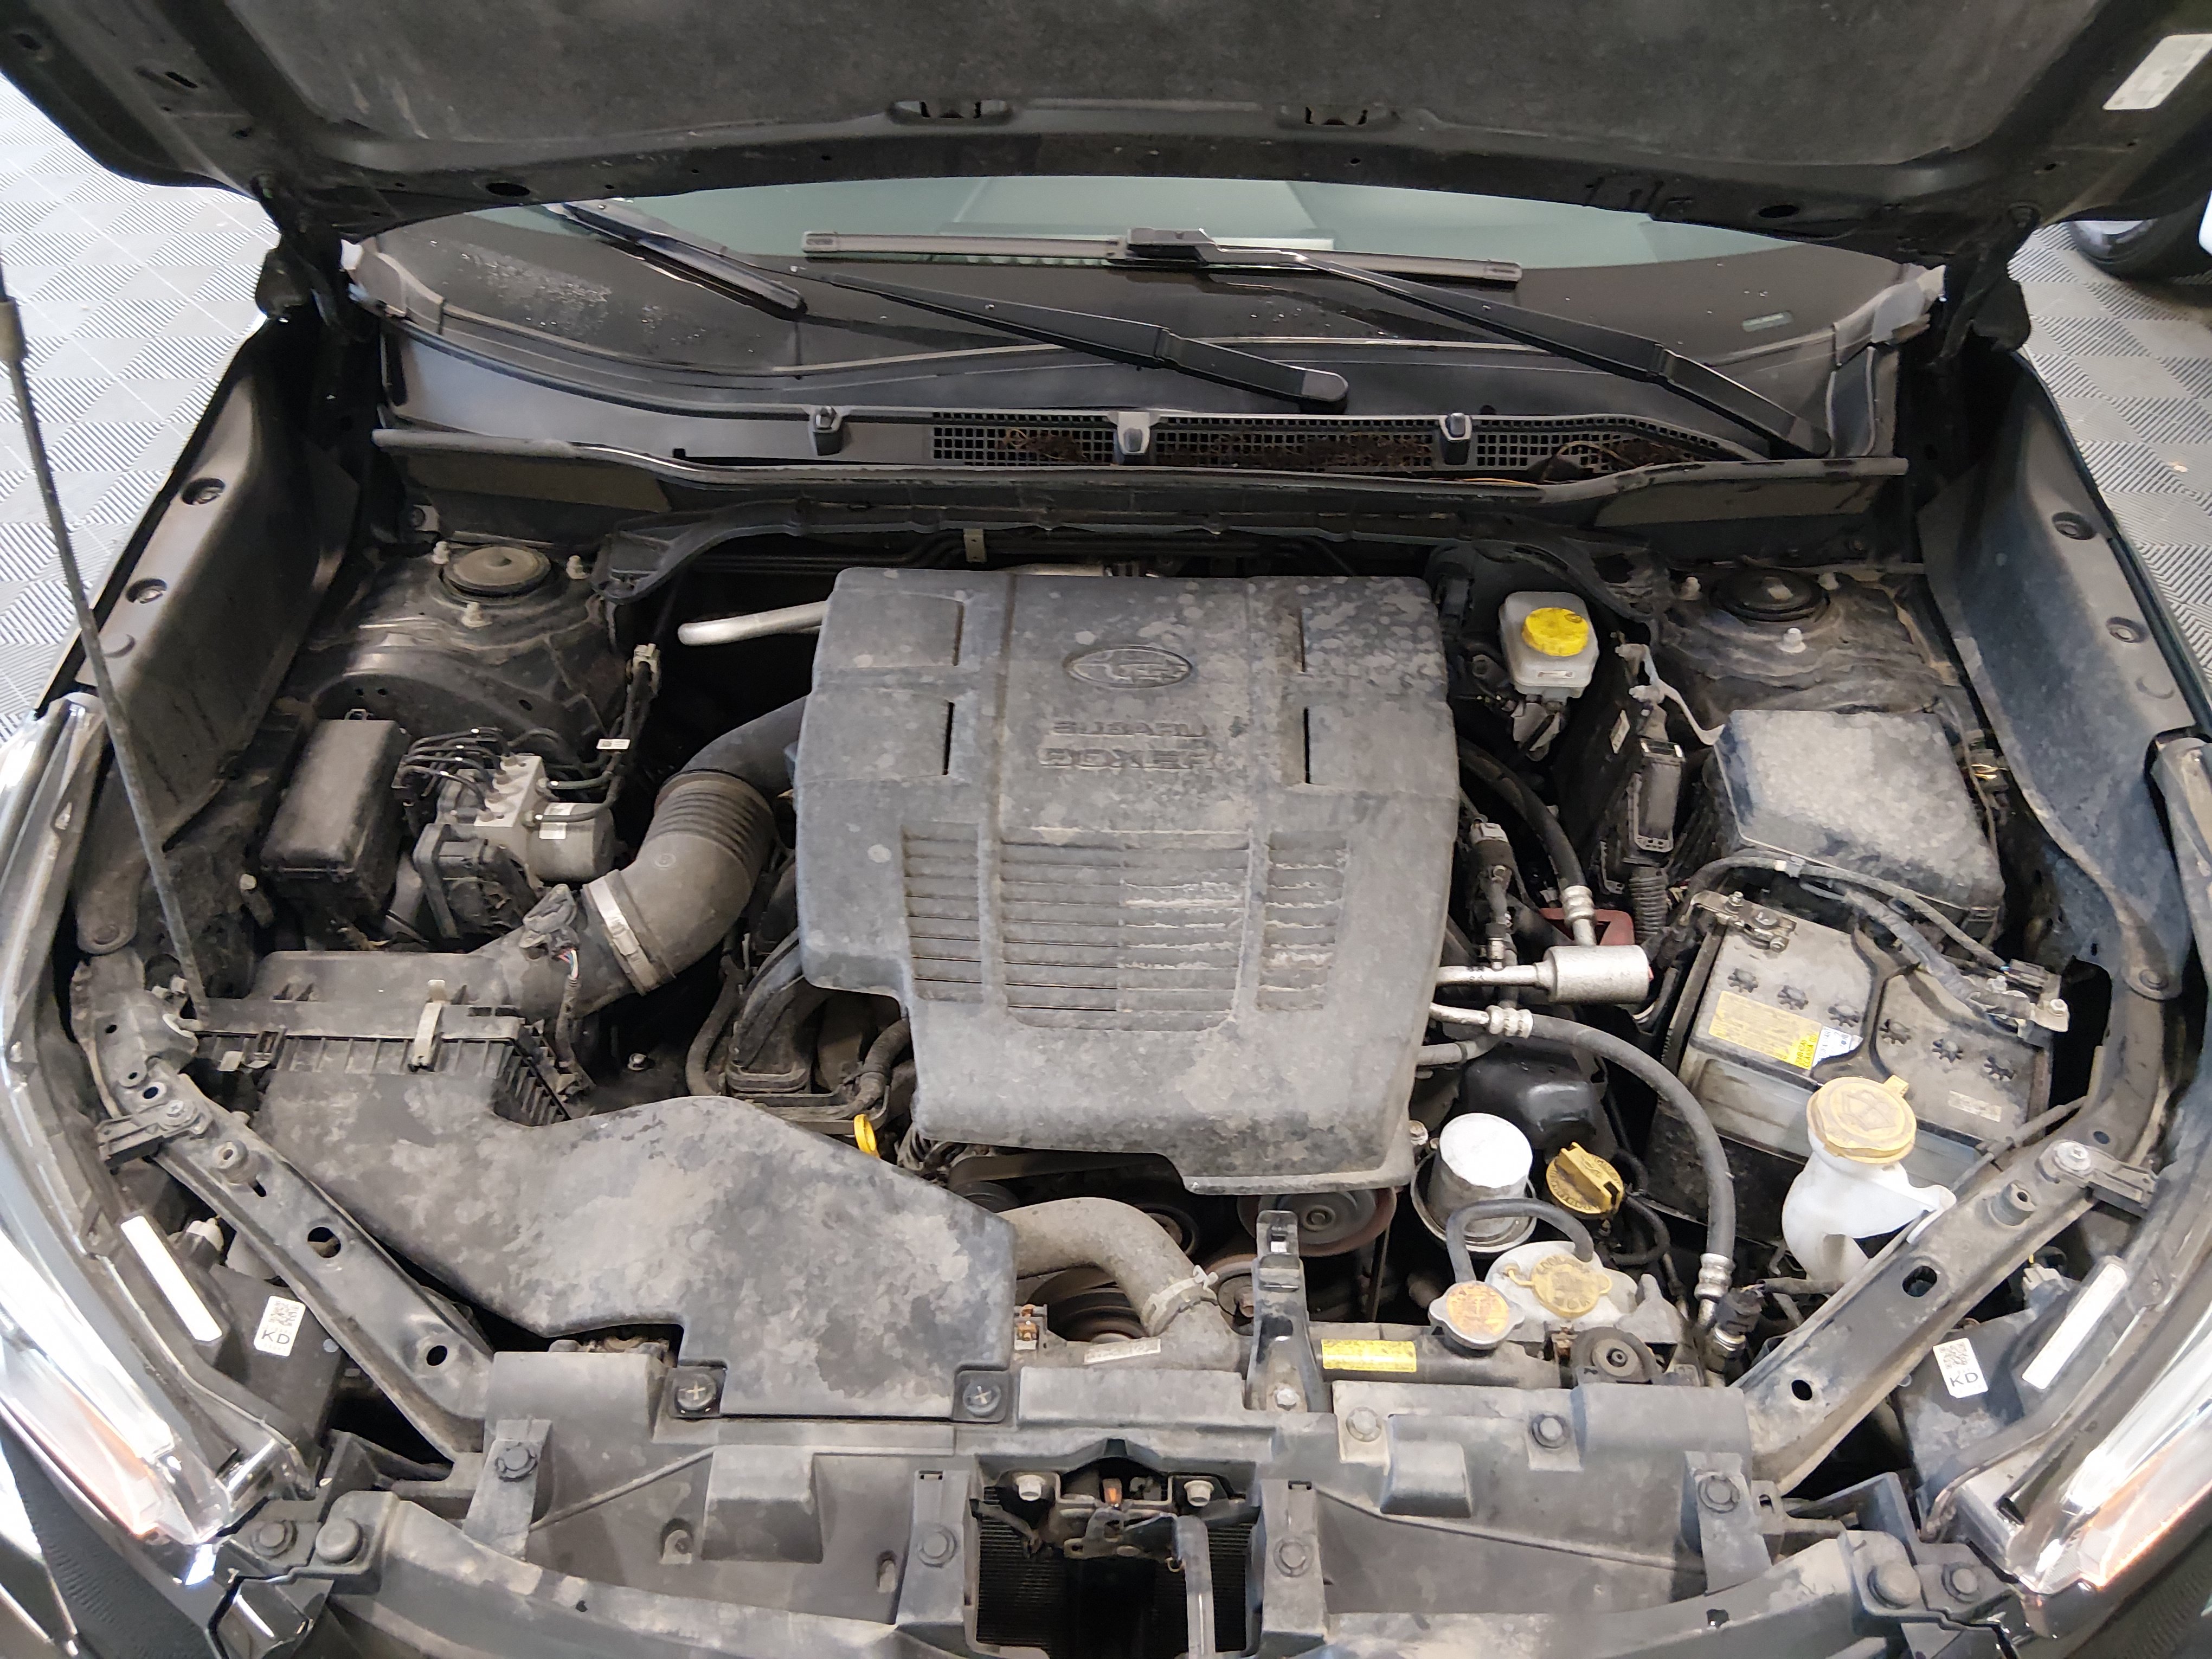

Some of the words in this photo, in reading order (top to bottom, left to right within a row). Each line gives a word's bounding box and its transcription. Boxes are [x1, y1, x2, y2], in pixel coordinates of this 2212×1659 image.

[1052, 719, 1210, 738] SUBARU
[1039, 747, 1217, 770] BOXER
[261, 1329, 290, 1345] KD
[1950, 1372, 1978, 1387] KD
